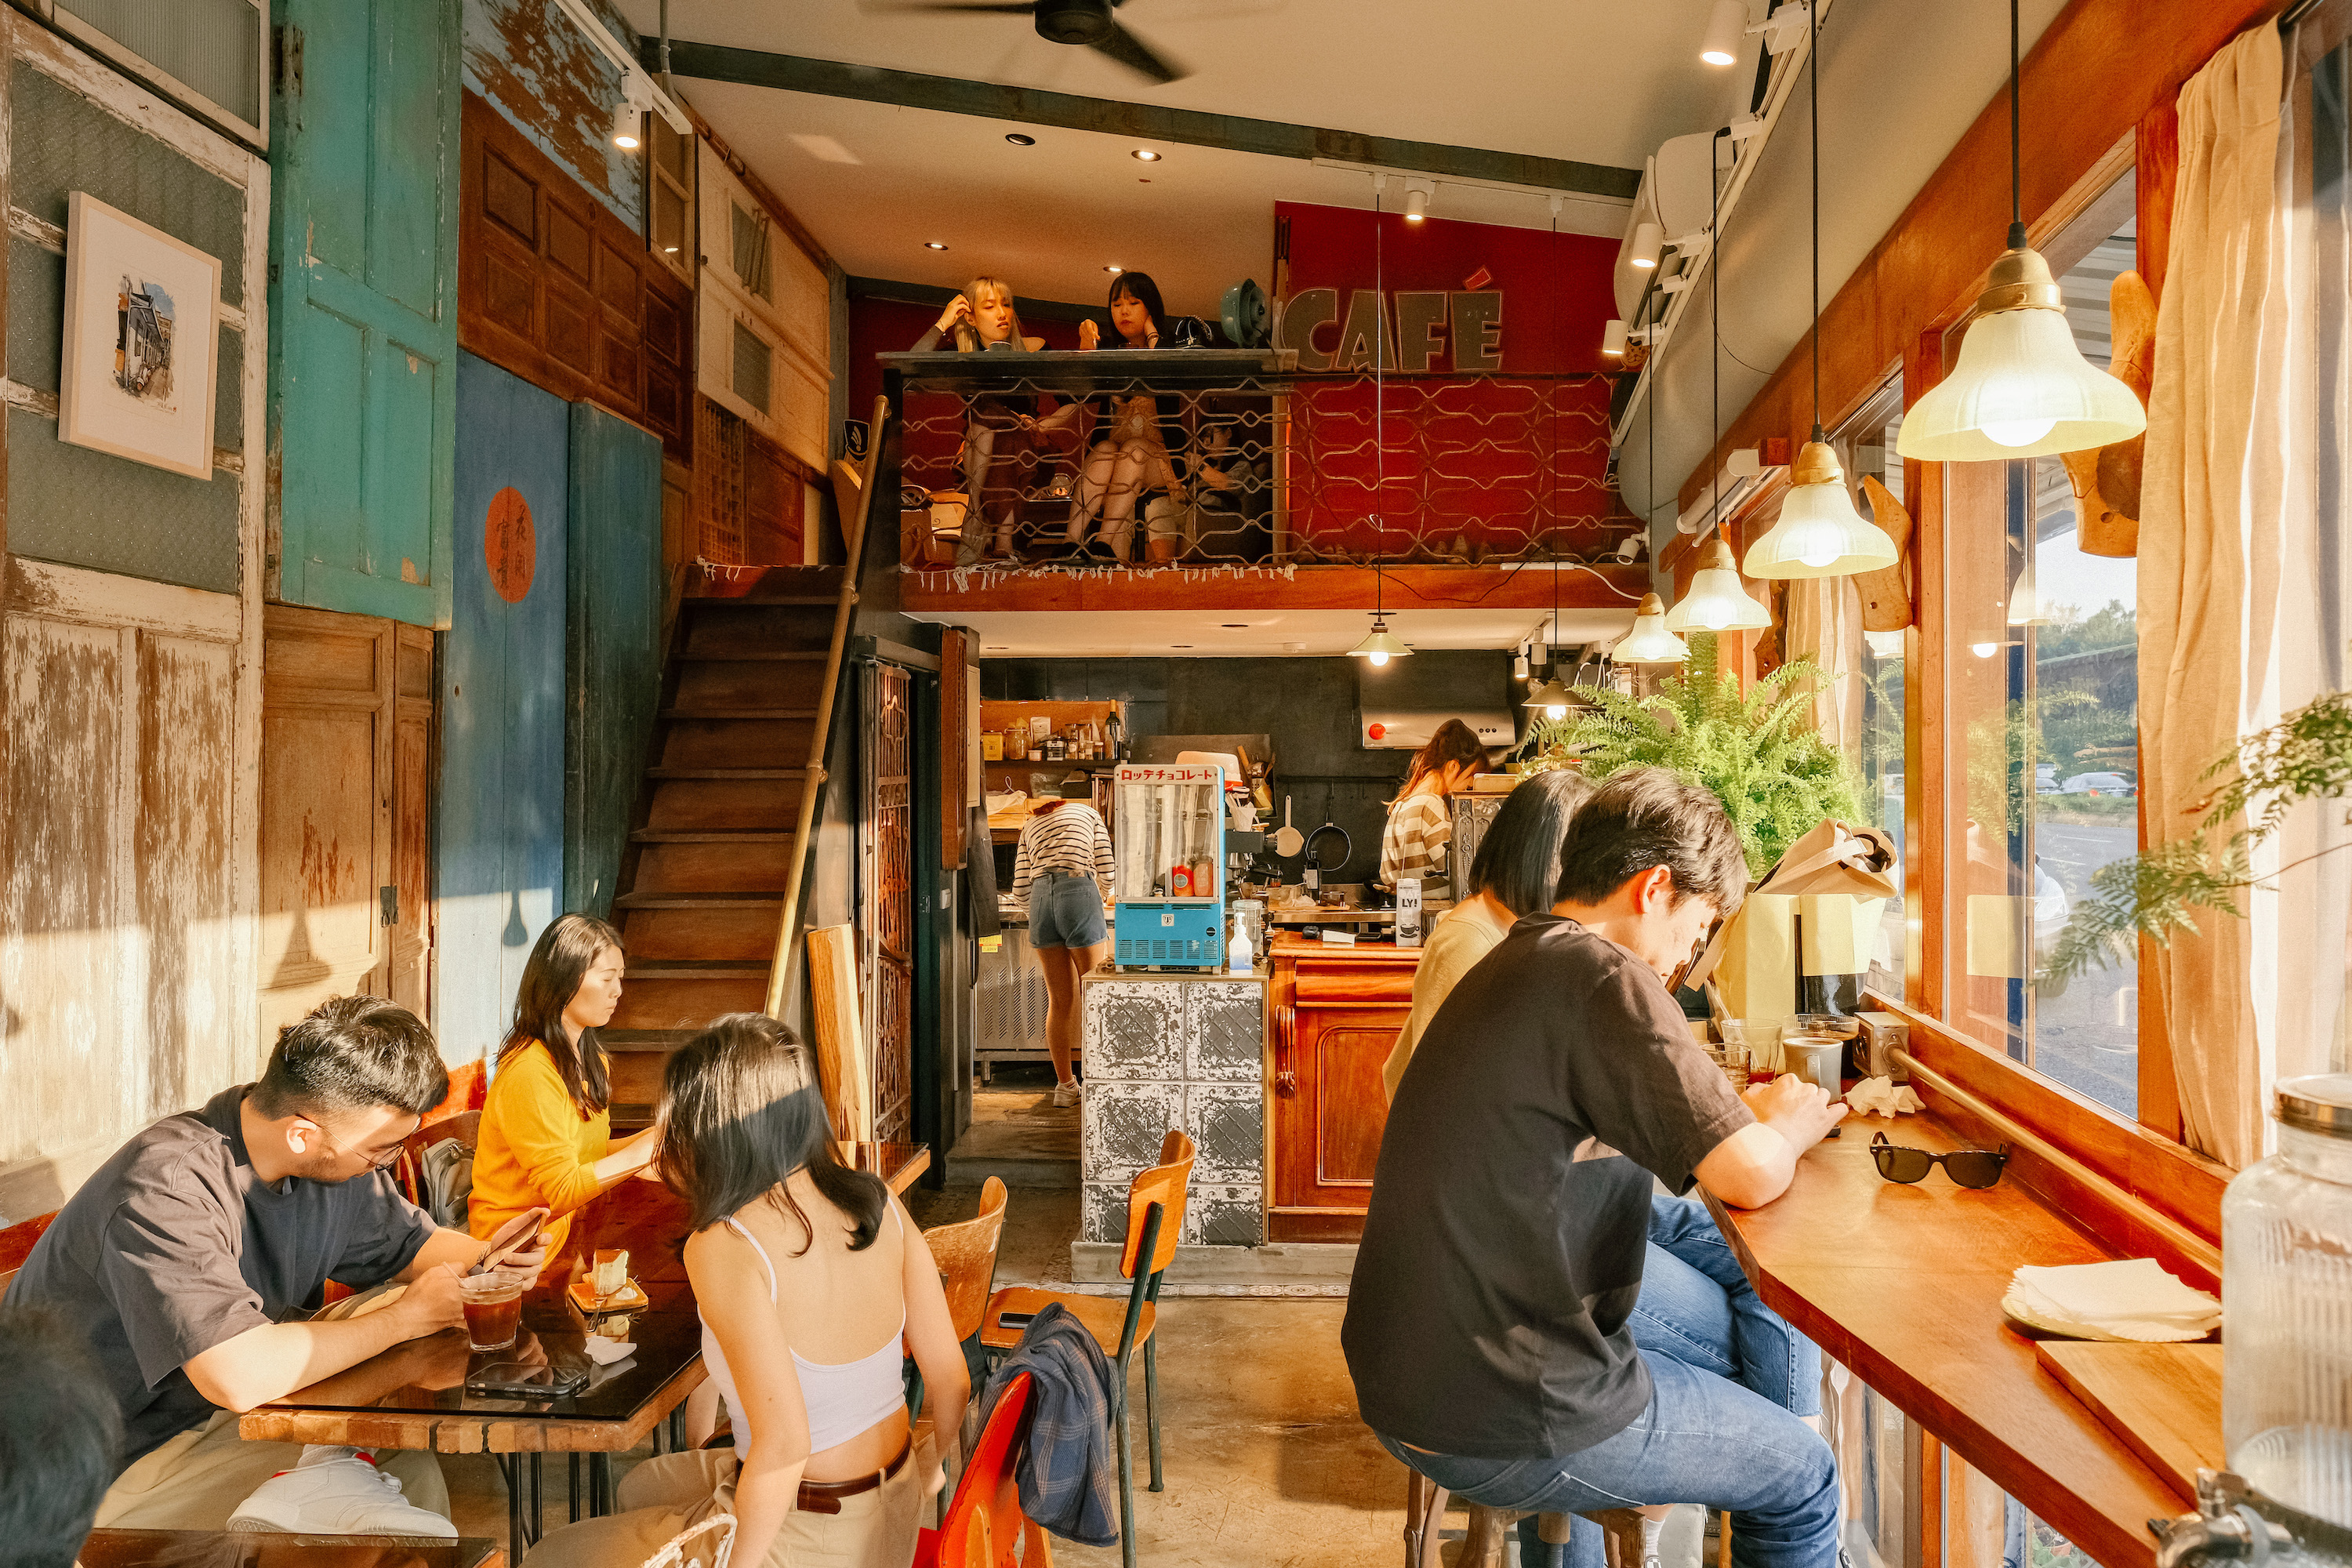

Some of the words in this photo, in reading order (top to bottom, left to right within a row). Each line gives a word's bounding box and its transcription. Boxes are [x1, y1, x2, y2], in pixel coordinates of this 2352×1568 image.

[1280, 265, 1503, 372] CAFÉ
[1121, 769, 1212, 781] ロッテチョコレート
[1398, 889, 1420, 898] OAT
[1402, 898, 1417, 908] LY!
